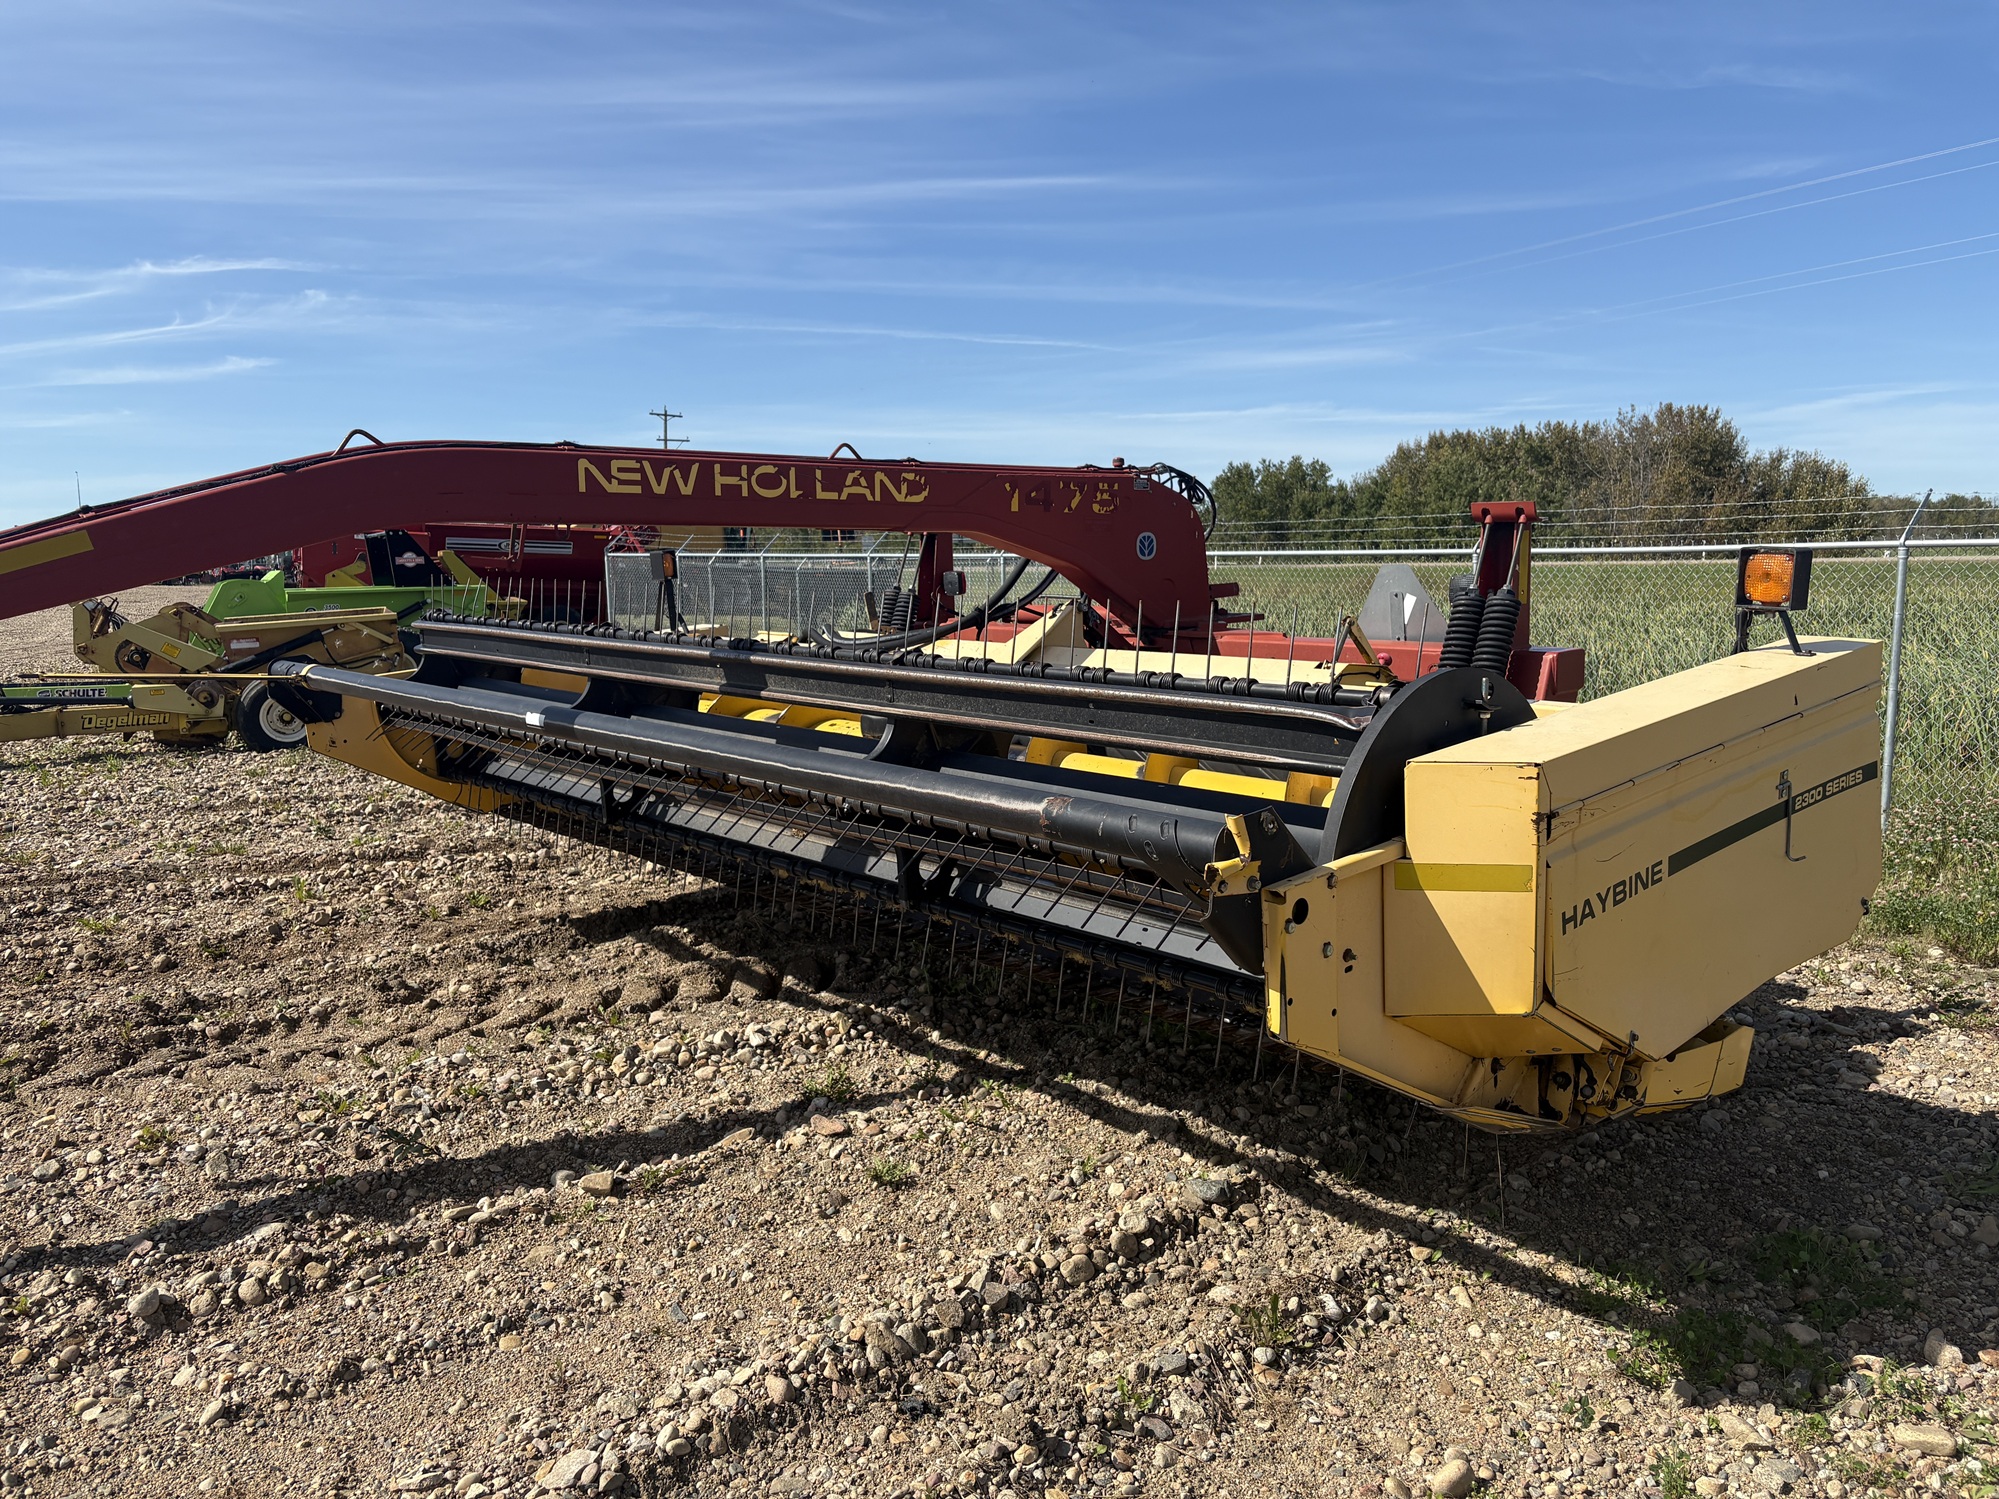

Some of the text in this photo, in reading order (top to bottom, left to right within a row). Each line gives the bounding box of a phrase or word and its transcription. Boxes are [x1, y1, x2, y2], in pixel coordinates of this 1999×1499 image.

[577, 458, 930, 503] NEW HOLLAND
[54, 687, 107, 699] SCHULTE
[82, 711, 170, 731] Degelman
[1794, 769, 1863, 810] 2300 SERIES
[1561, 860, 1663, 936] HAYBINE
